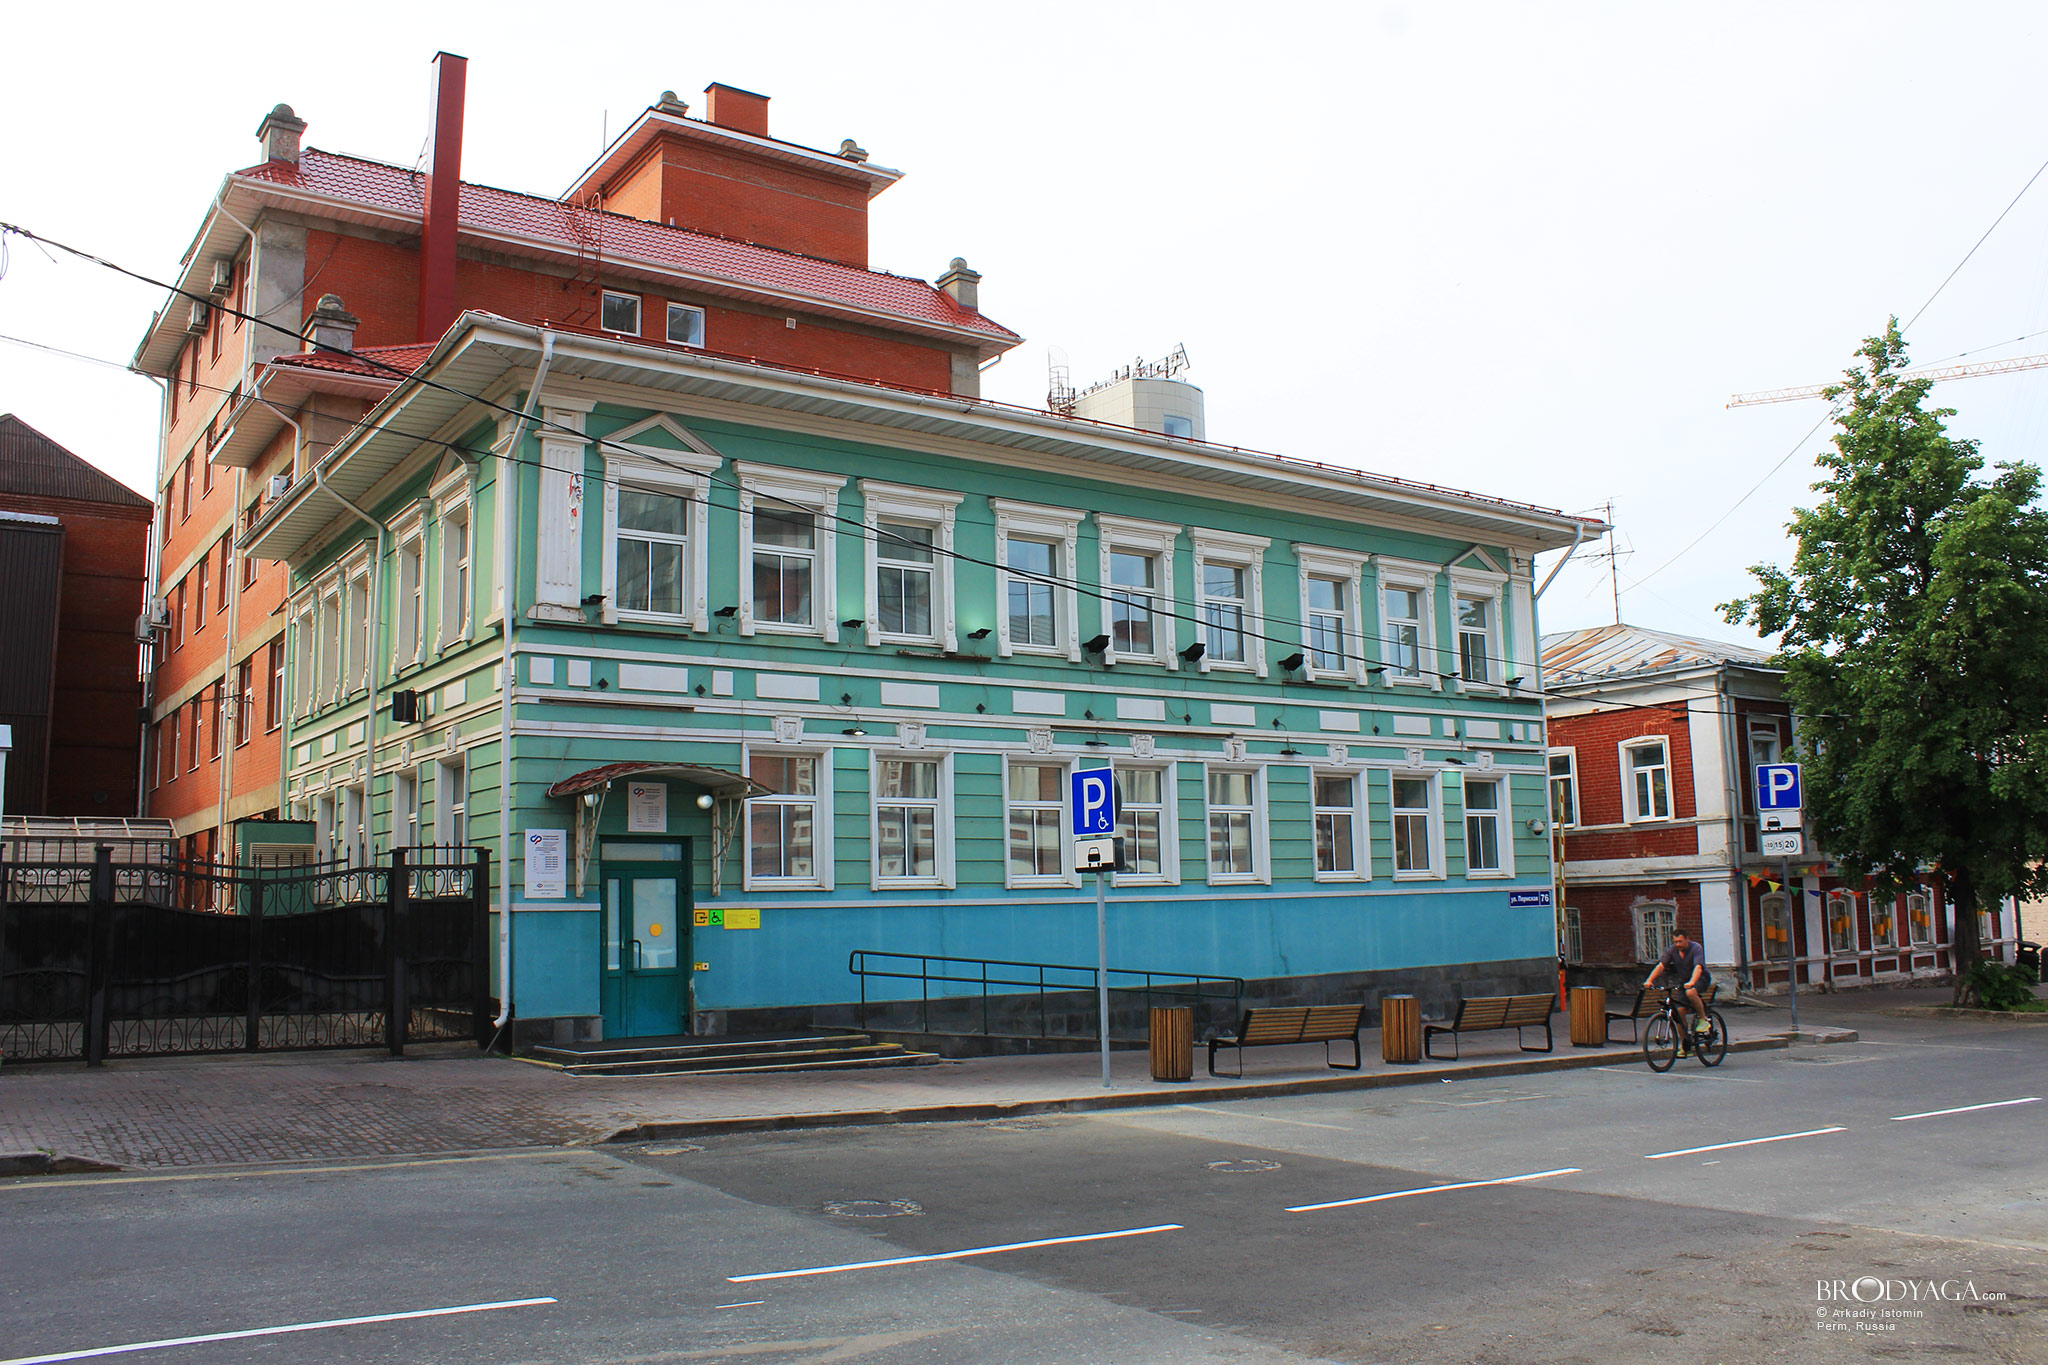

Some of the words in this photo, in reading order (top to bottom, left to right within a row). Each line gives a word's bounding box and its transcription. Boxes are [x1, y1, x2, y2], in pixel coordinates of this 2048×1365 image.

[1083, 777, 1106, 828] P
[1768, 768, 1795, 806] P
[1540, 894, 1549, 902] 76
